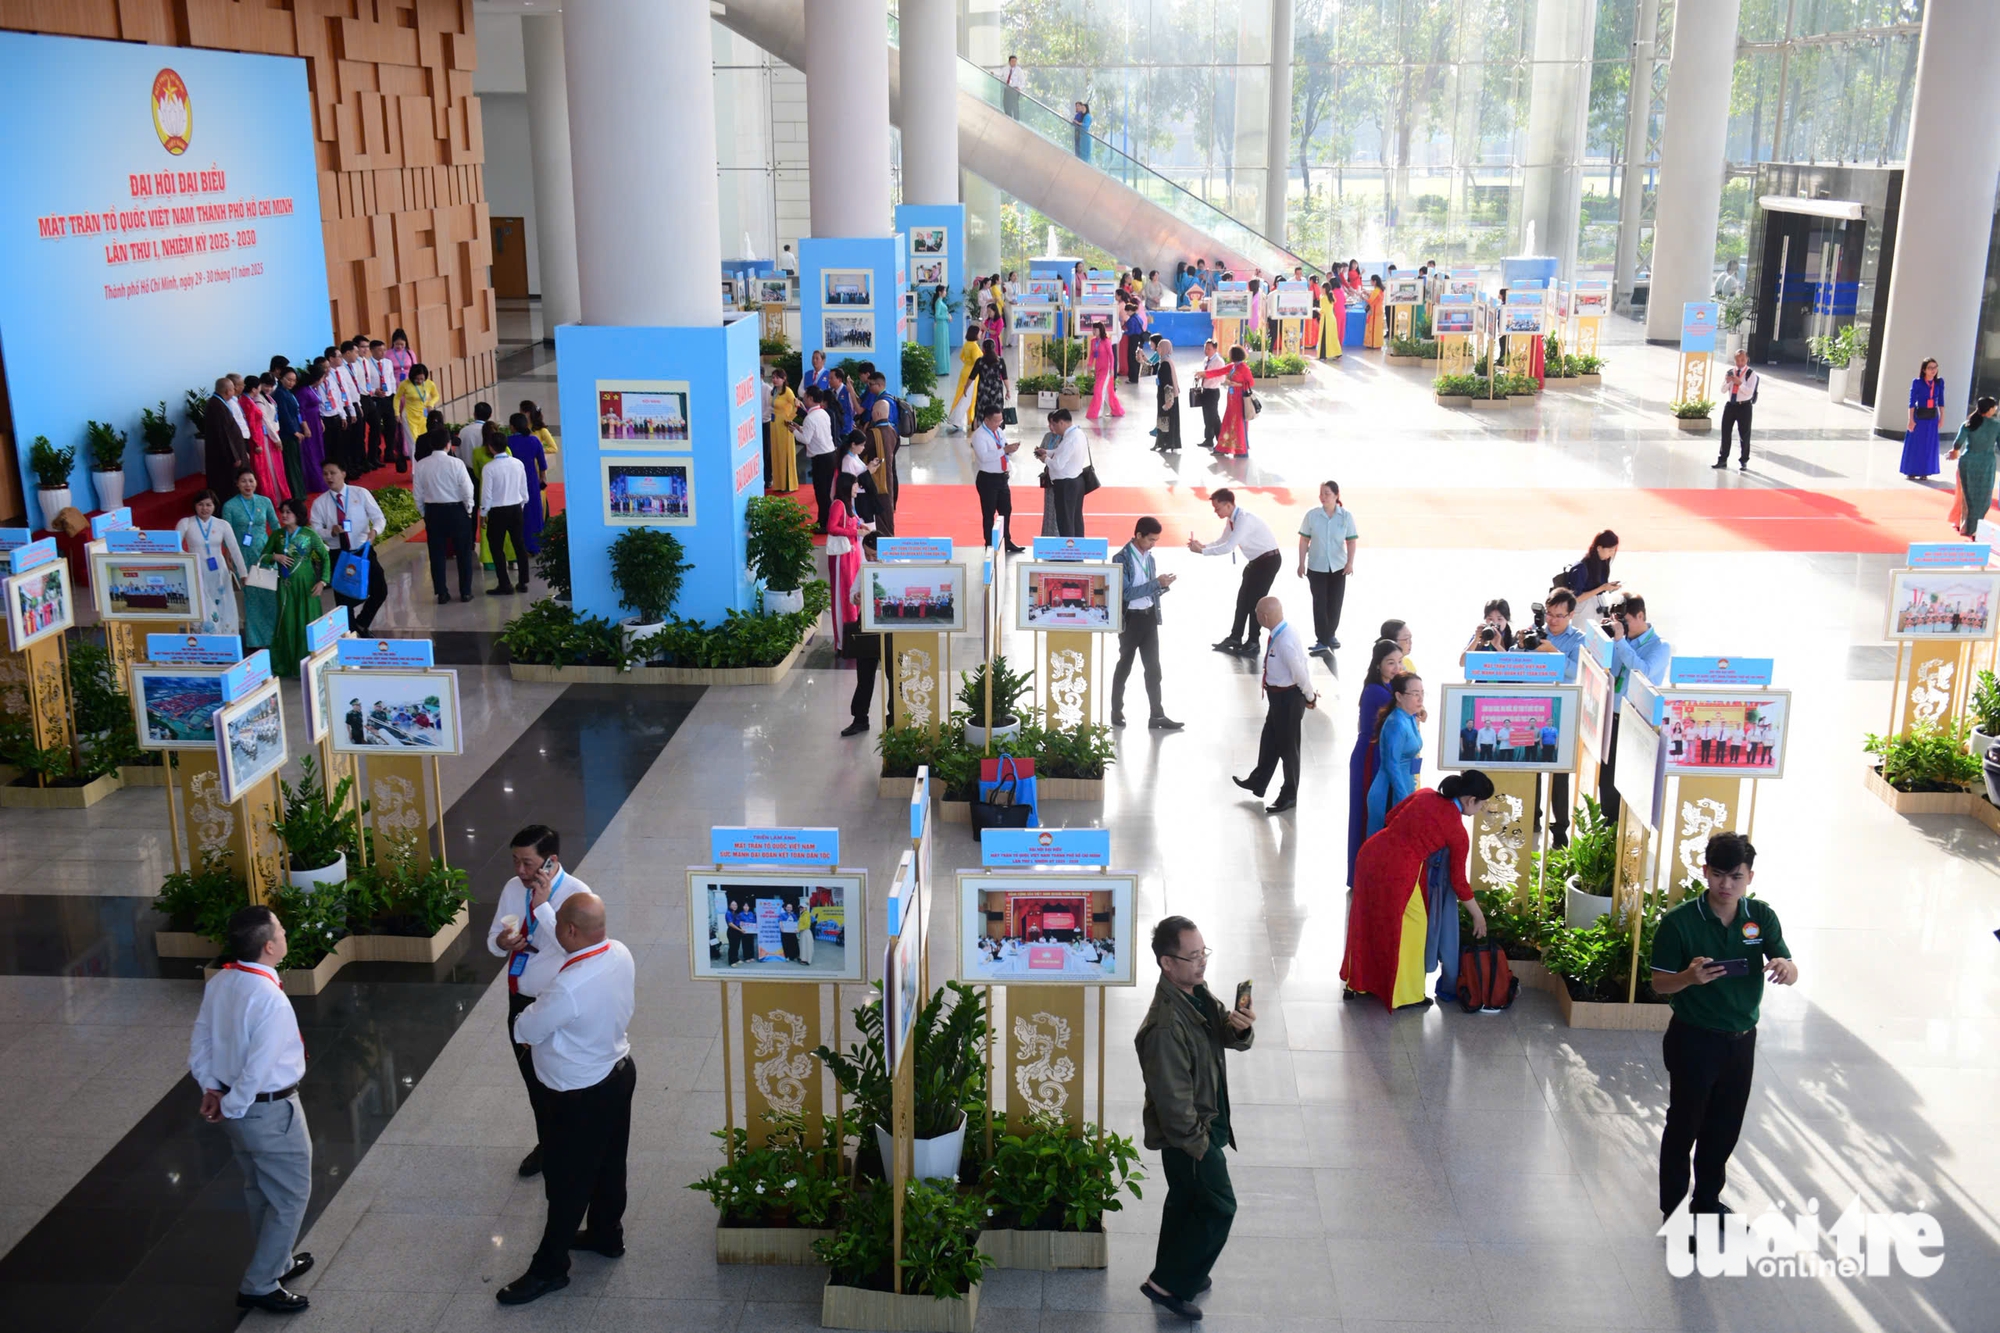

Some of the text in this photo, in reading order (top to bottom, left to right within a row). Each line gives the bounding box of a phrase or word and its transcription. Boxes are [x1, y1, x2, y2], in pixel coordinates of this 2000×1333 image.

[129, 162, 226, 201] ĐẠI HỘI ĐẠI BIỂU
[38, 195, 294, 241] MẶT TRẬN TỔ QUỐC VIỆT NAM THÀNH PHỐ HỒ CHÍ MINH
[105, 238, 128, 264] LẦN
[130, 238, 151, 260] THỨ
[152, 240, 161, 260] I,
[162, 234, 194, 258] NHIỆM
[194, 232, 207, 252] KỲ
[208, 232, 230, 250] 2025
[236, 229, 257, 247] 2030
